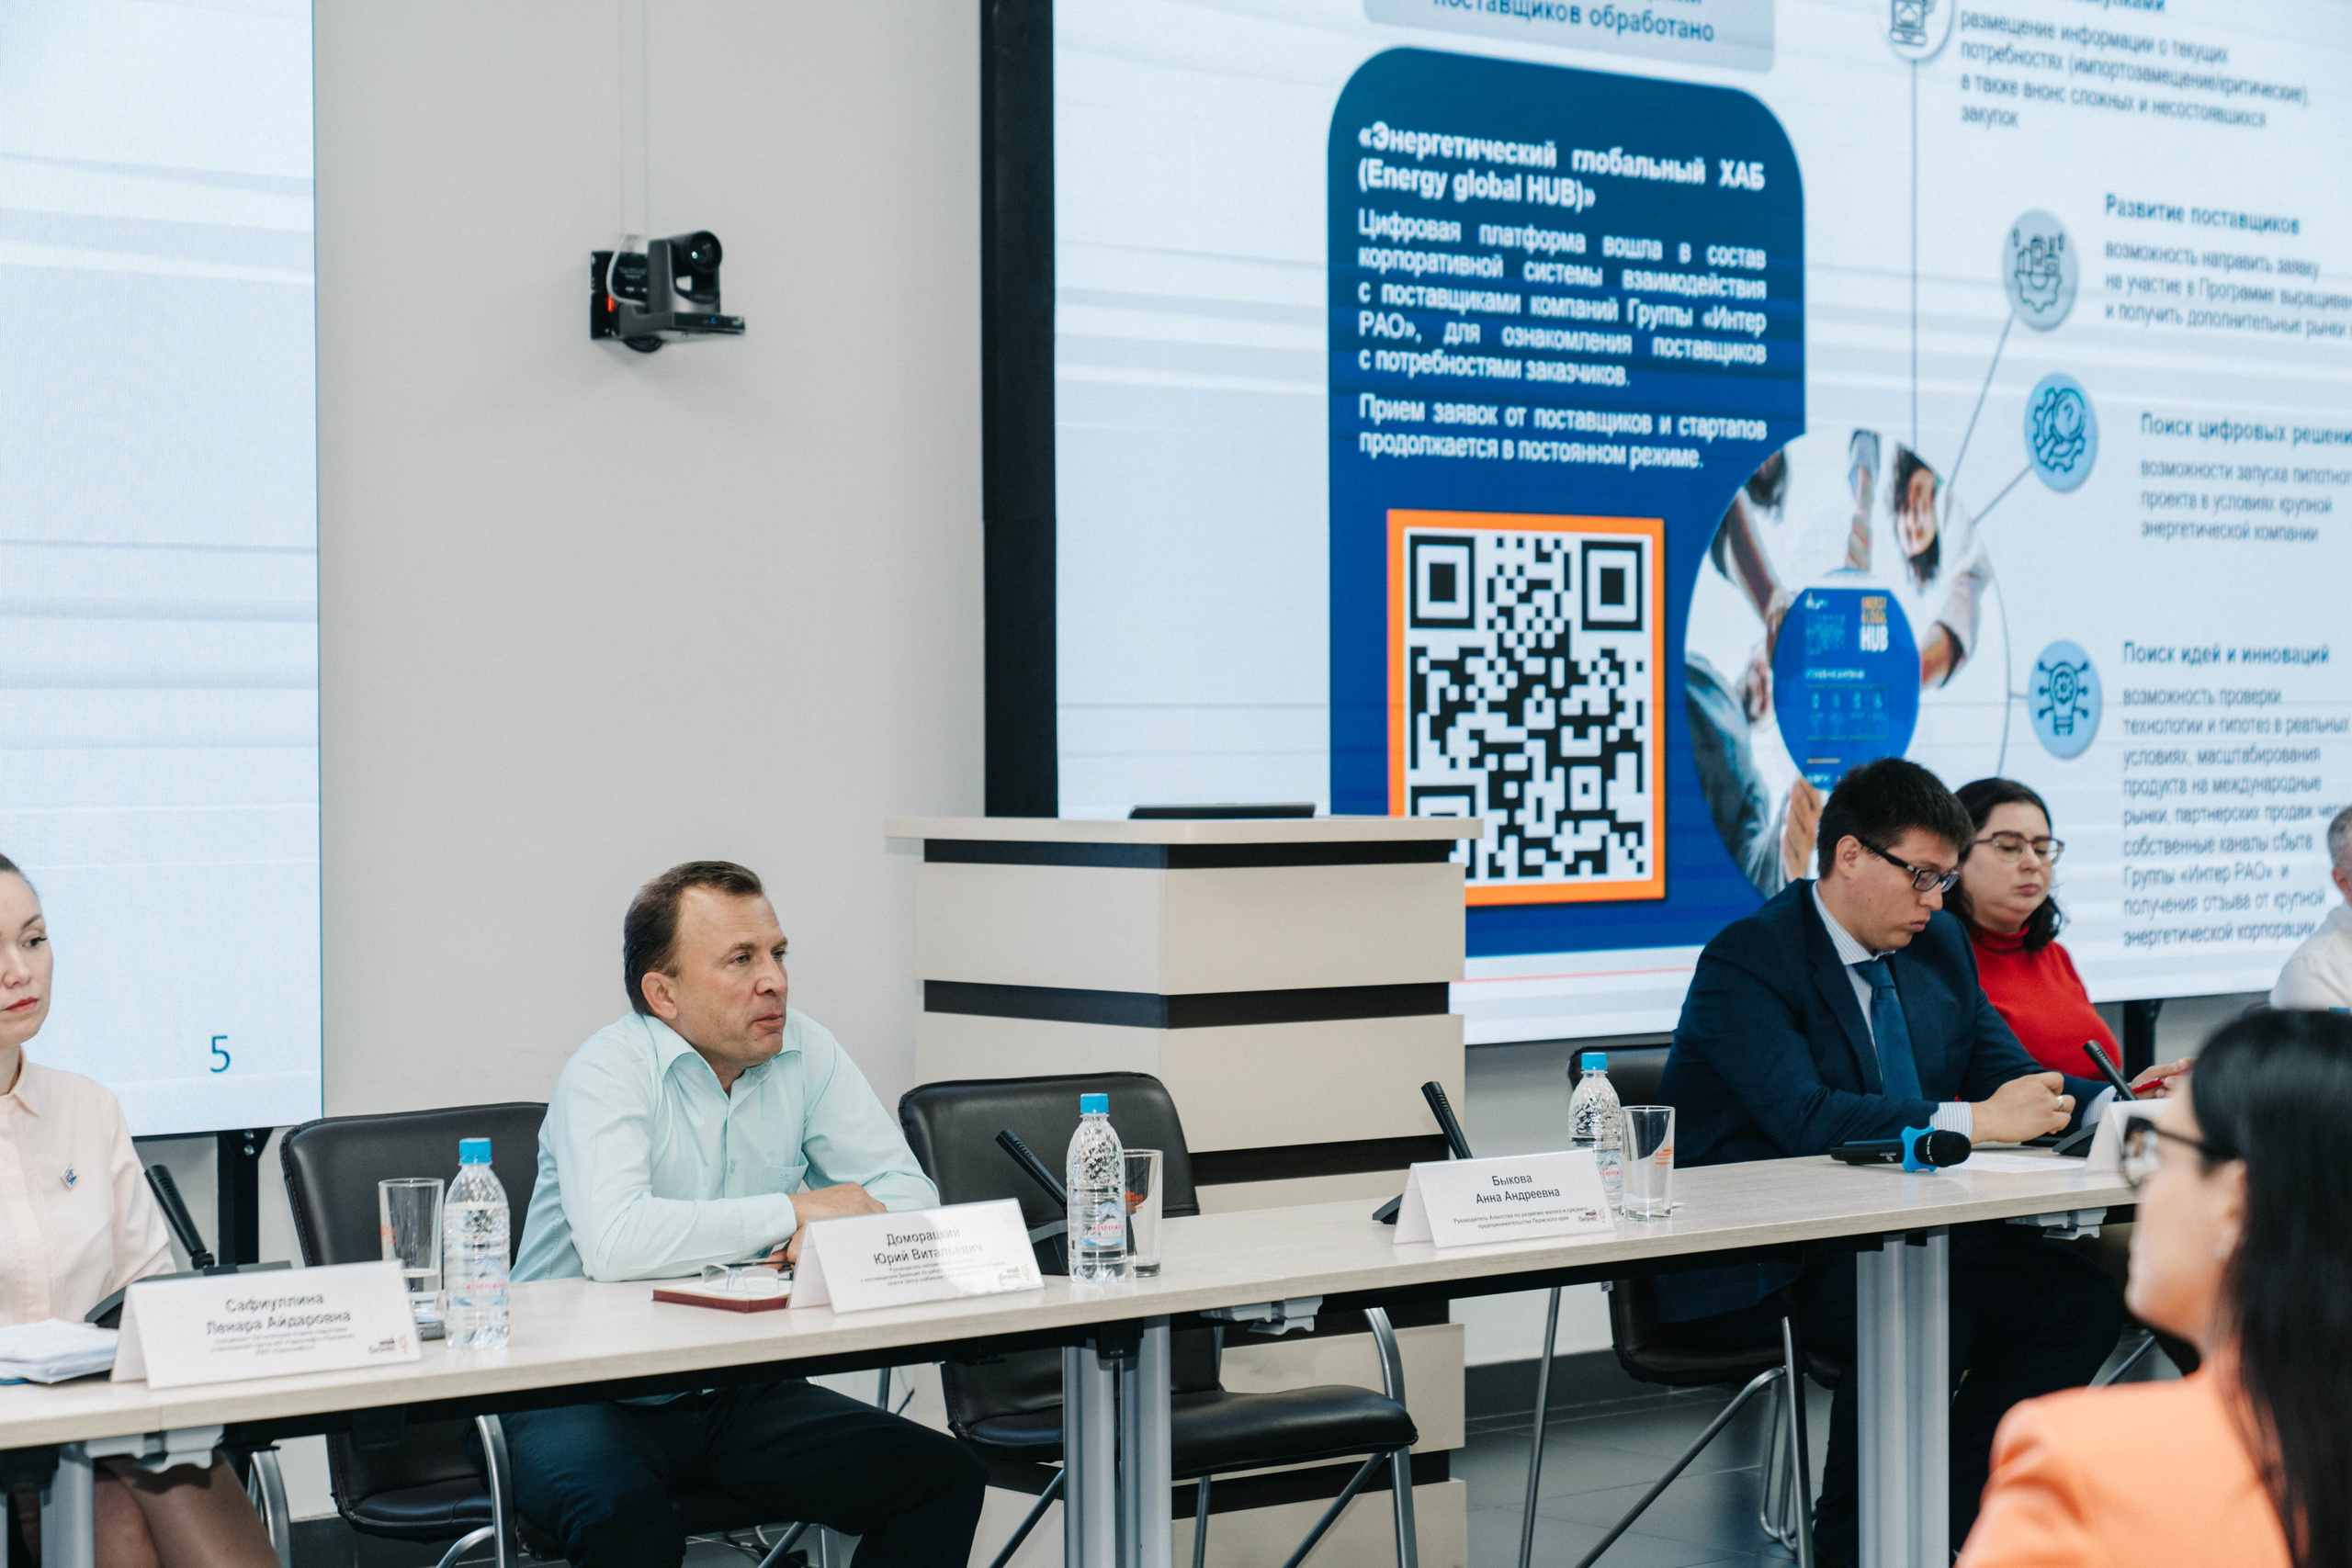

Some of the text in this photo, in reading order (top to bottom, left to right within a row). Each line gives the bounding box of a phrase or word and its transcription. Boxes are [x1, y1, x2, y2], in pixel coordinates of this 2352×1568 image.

[1589, 7, 1714, 41] обработано
[1961, 10, 2228, 64] размещение информации о текущих
[1961, 41, 2063, 71] потребностях
[1975, 75, 2018, 96] также
[2071, 88, 2134, 111] сложных
[2139, 97, 2148, 113] и
[2153, 99, 2267, 128] несостоявшихся
[1962, 105, 2018, 130] закупок
[1358, 120, 1766, 191] «Энергетический глобальный ХАБ
[1358, 157, 1596, 214] (Energy global HUB)»
[2105, 193, 2301, 236] Развитие поставщиков
[1358, 207, 1767, 271] Цифровая платформа вошла в состав
[1358, 246, 1767, 300] корпоративной системы взаимодействия
[2106, 242, 2321, 283] возможность направить заявку
[2106, 274, 2122, 290] на
[2127, 276, 2182, 297] участие
[2187, 281, 2195, 297] в
[2199, 277, 2275, 302] Программе
[1358, 281, 1767, 338] с поставщиками компаний Группы «Интер
[2105, 303, 2346, 340] и получить дополнительные рынки
[1359, 310, 1767, 367] РАО», для ознакомления поставщиков
[1358, 347, 1631, 387] с потребностями заказчиков.
[1359, 392, 1768, 444] Прием заявок от поставщиков и стартапов
[2142, 412, 2193, 436] Поиск
[2199, 418, 2286, 445] цифровых
[1359, 432, 1703, 471] продолжается в постоянном режиме.
[2142, 460, 2233, 480] возможности
[2237, 465, 2289, 487] запуска
[2142, 491, 2333, 518] проекта в условиях крупной
[2142, 521, 2319, 543] энергетической компании
[1860, 625, 1889, 652] HUB
[2123, 641, 2329, 667] Поиск идей и инноваций
[2123, 689, 2282, 708] возможность проверки
[2123, 716, 2349, 736] технологии и гипотез в реальных
[2197, 743, 2321, 768] масштабирования
[2123, 775, 2322, 800] продукта на международные
[2176, 807, 2260, 827] партнерских
[2265, 805, 2312, 825] продаж
[2123, 829, 2312, 857] собственные каналы сбыта
[2123, 861, 2290, 890] Группы «Интер РАО» и
[2123, 887, 2326, 920] получения отзыва от крупной
[2123, 921, 2315, 950] энергетической корпорации
[210, 1034, 231, 1073] 5
[1491, 1174, 1532, 1187] Быкова
[1476, 1188, 1560, 1204] Анна Андреевна
[1453, 1215, 1488, 1224] Руководитель
[1489, 1213, 1514, 1221] Агентства
[1521, 1210, 1544, 1219] развитию
[1566, 1206, 1589, 1214] среднего
[1477, 1219, 1532, 1230] предпринимательства
[1532, 1216, 1557, 1224] Пермского
[887, 1226, 961, 1247] Доморацкий
[873, 1249, 910, 1267] Юрий
[911, 1243, 984, 1261] Витальевич
[225, 1293, 325, 1314] Сафиуллина
[207, 1317, 263, 1336] Ленара
[266, 1311, 352, 1330] Айдаровна
